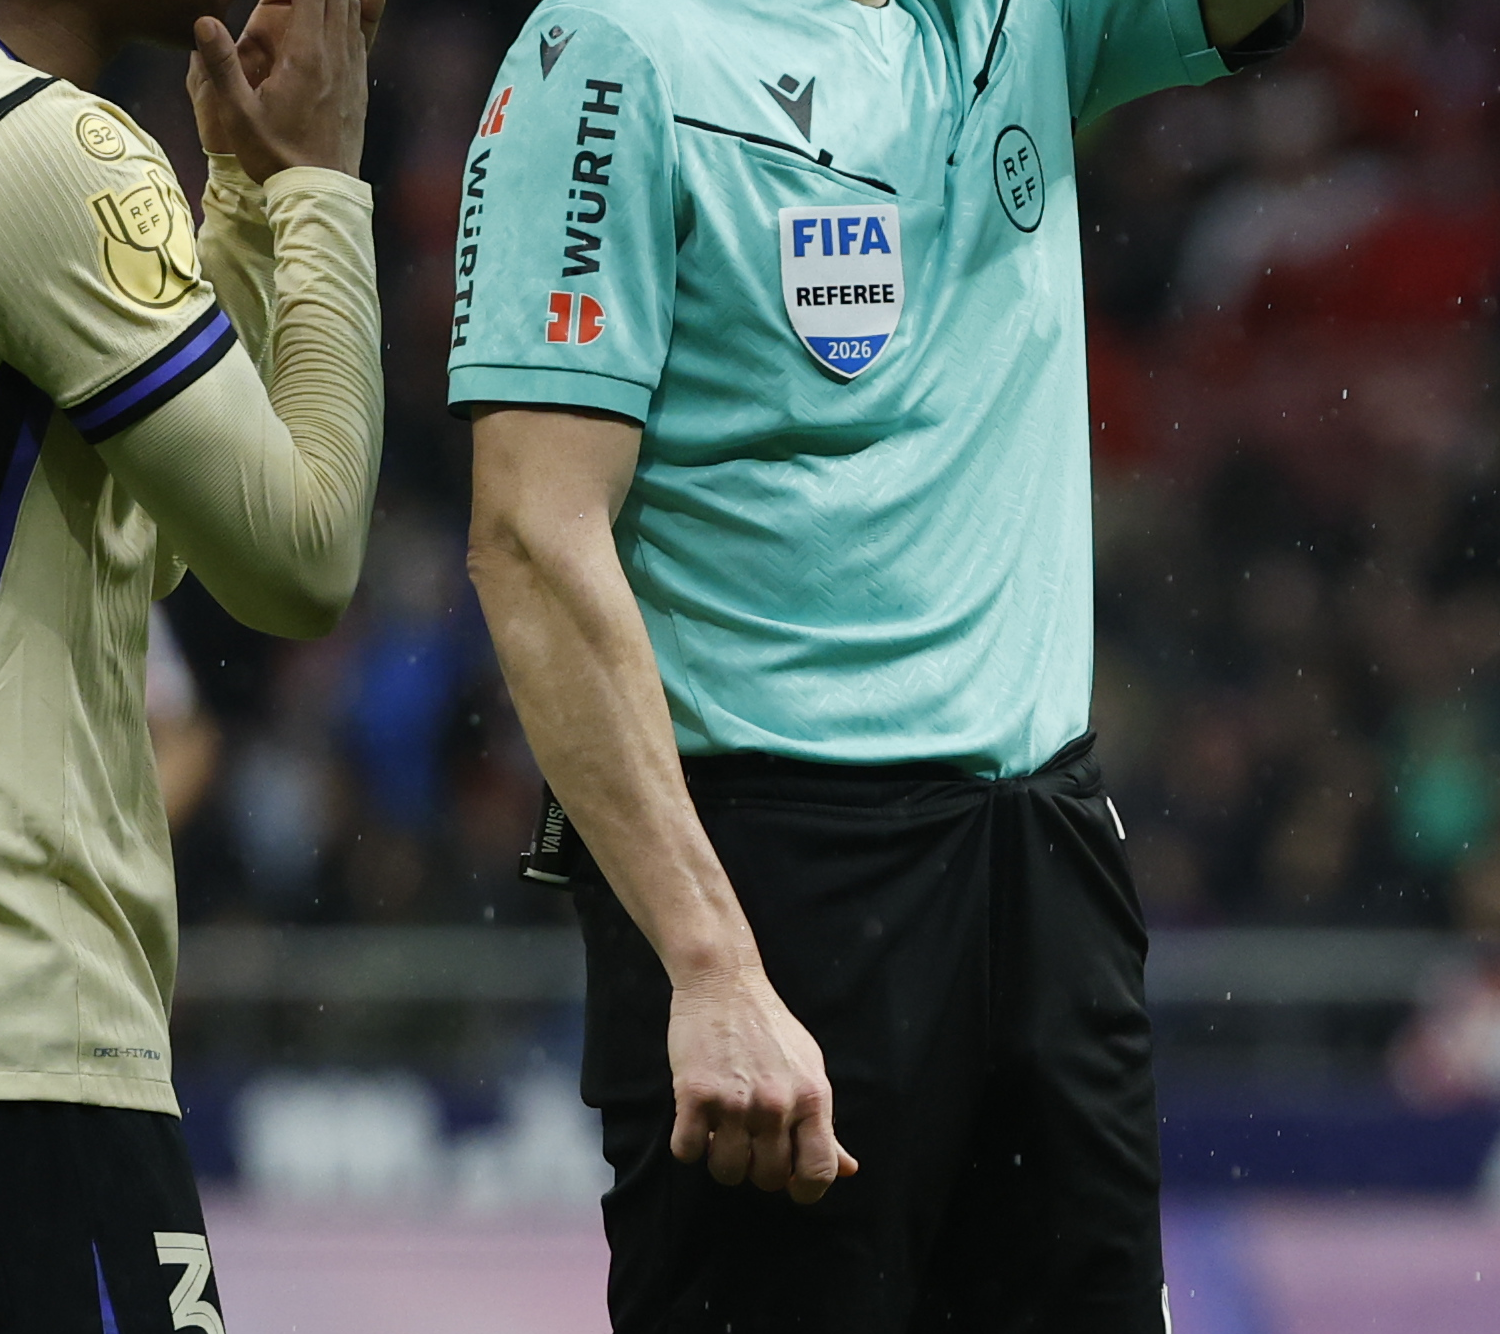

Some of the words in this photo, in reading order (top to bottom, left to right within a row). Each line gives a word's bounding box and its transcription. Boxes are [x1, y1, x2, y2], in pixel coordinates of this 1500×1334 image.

[88, 126, 116, 145] 32
[561, 78, 623, 278] WÜRTH
[452, 148, 491, 350] WÜRTH
[792, 217, 892, 258] FIFA
[796, 283, 895, 307] REFEREE
[827, 340, 873, 360] 2026
[541, 802, 565, 853] VANIS
